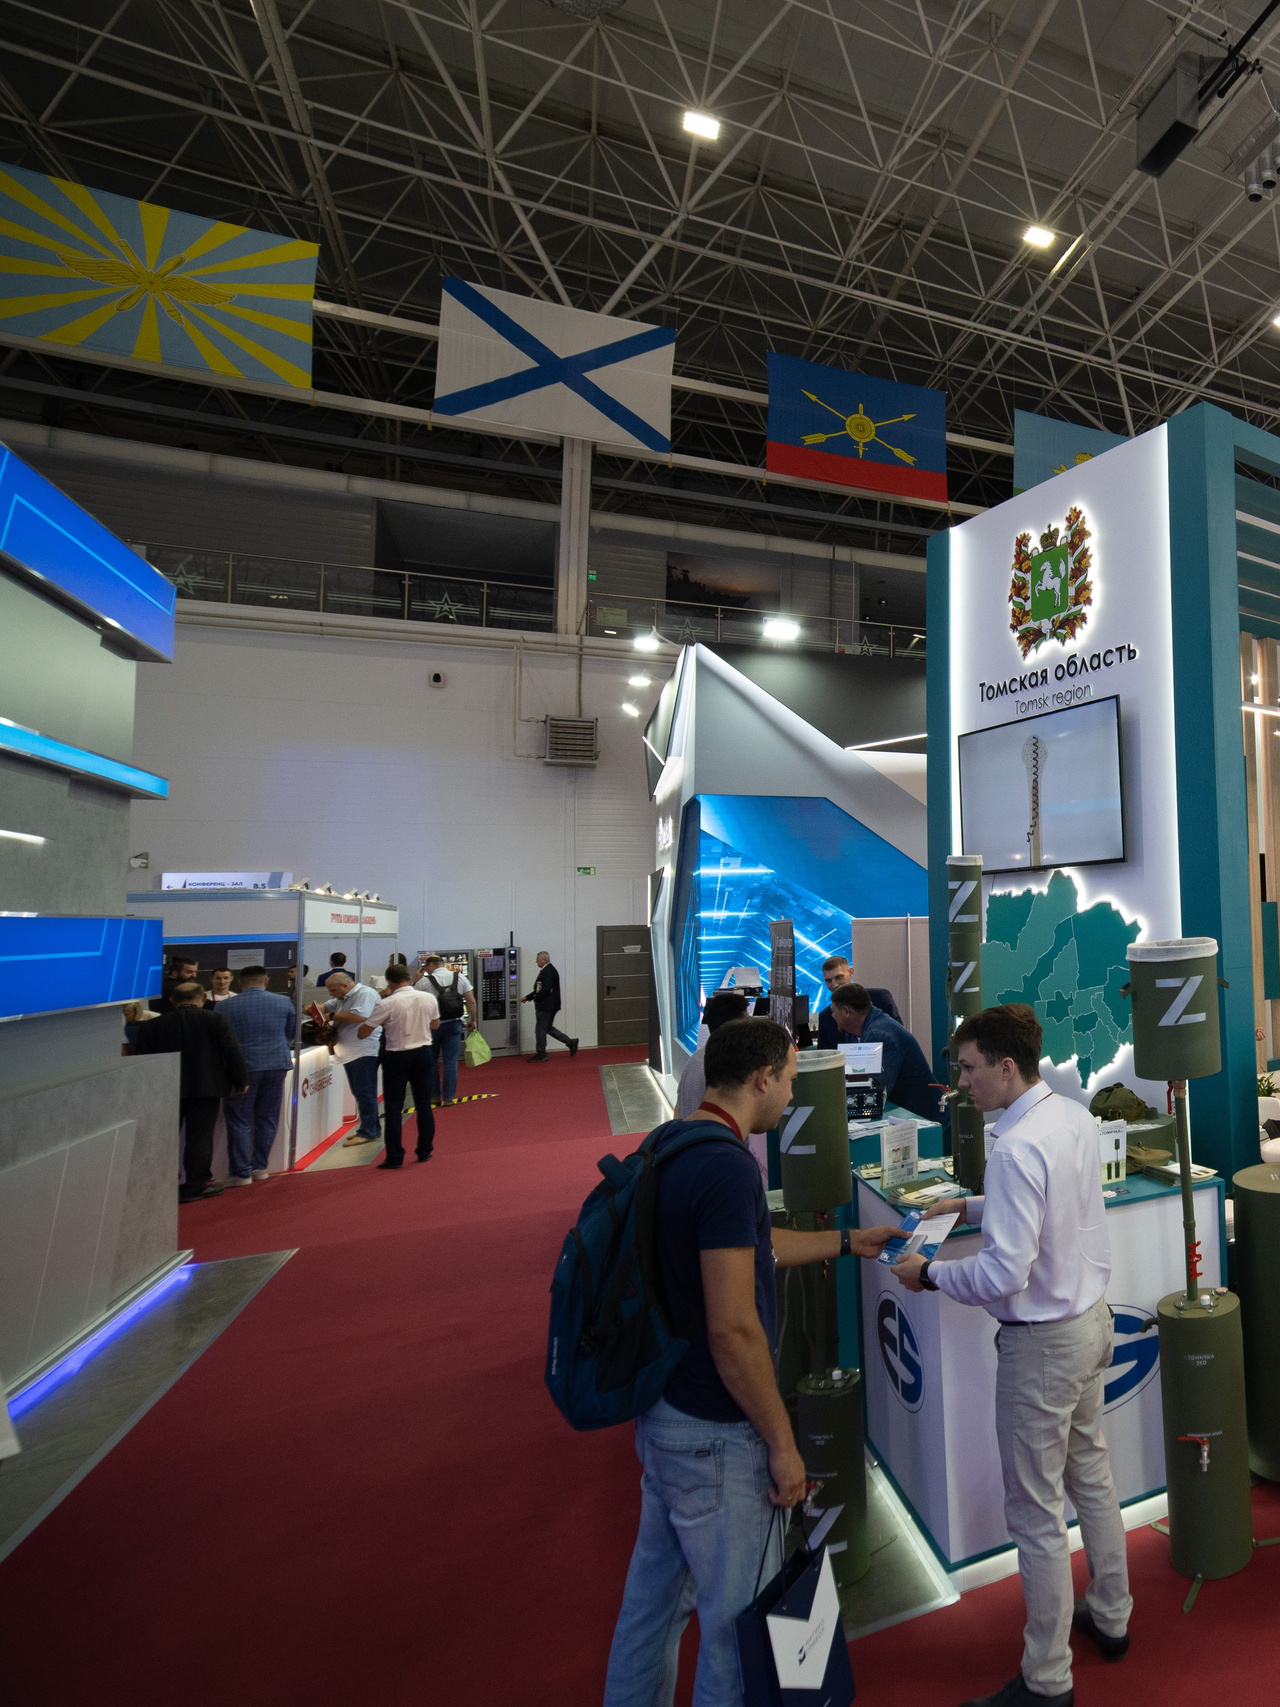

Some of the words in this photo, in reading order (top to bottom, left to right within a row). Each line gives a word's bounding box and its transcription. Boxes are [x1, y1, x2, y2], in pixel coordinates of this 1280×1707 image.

[979, 668, 1048, 703] Томская
[1054, 643, 1138, 681] область
[1014, 692, 1049, 715] Tomsk
[1051, 684, 1092, 706] region
[948, 880, 979, 923] Z
[951, 961, 980, 993] Z
[1155, 974, 1206, 1026] Z
[779, 1105, 816, 1155] Z
